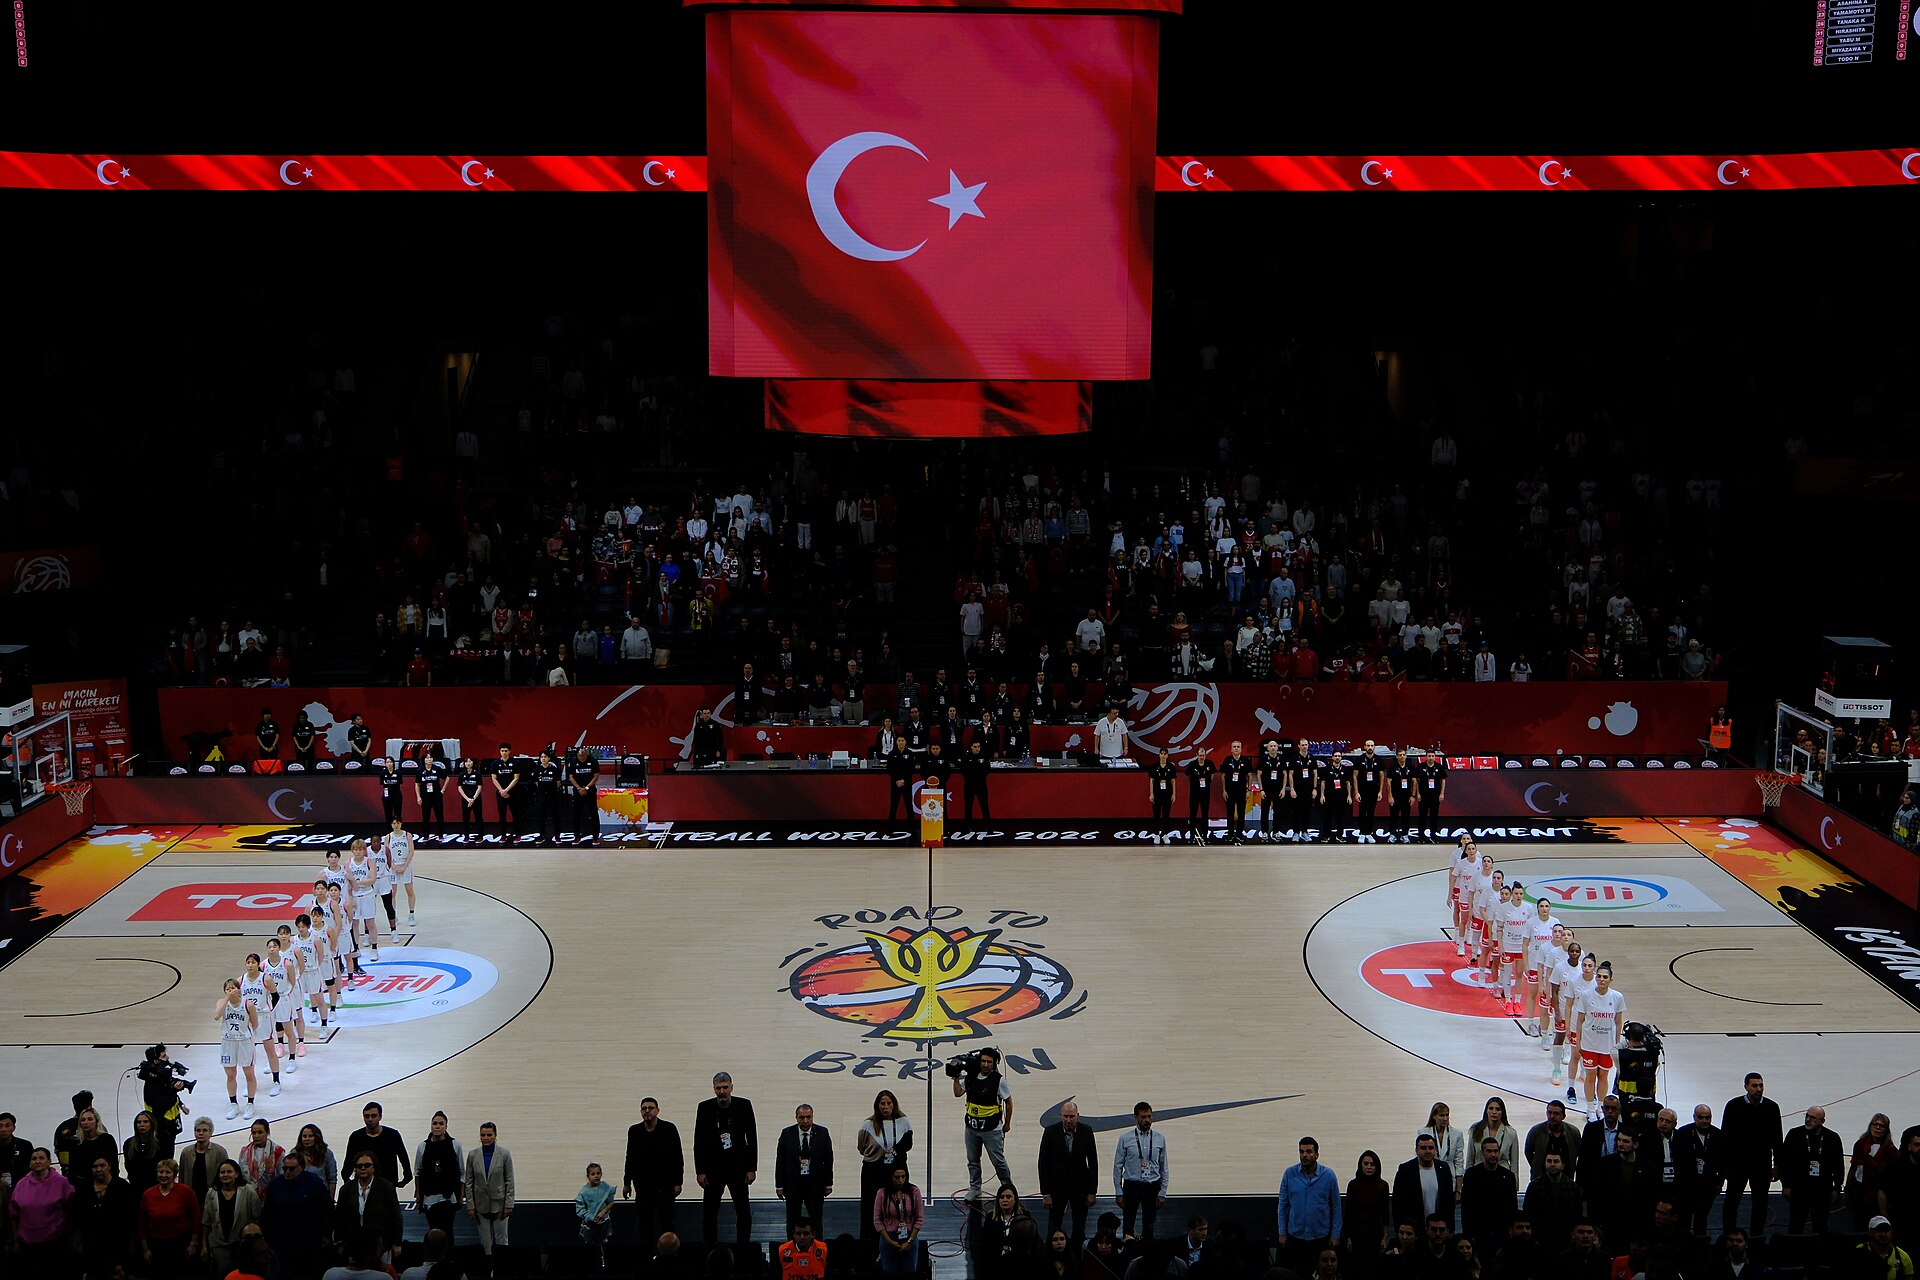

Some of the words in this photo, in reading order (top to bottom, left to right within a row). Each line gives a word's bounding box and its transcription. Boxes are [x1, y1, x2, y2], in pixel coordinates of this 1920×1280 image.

[42, 702, 56, 710] EN
[75, 694, 120, 708] HAREKETİ
[266, 834, 354, 844] FIBA
[787, 831, 911, 840] WORLD
[943, 831, 1004, 841] UP
[1014, 831, 1100, 840] 2026
[1544, 886, 1634, 900] Yili
[814, 906, 964, 930] ROAD
[988, 910, 1048, 928] TO
[243, 987, 262, 996] JAPAN
[225, 1012, 244, 1021] JAPAN
[229, 1023, 239, 1031] 75
[798, 1048, 1057, 1080] BERN
